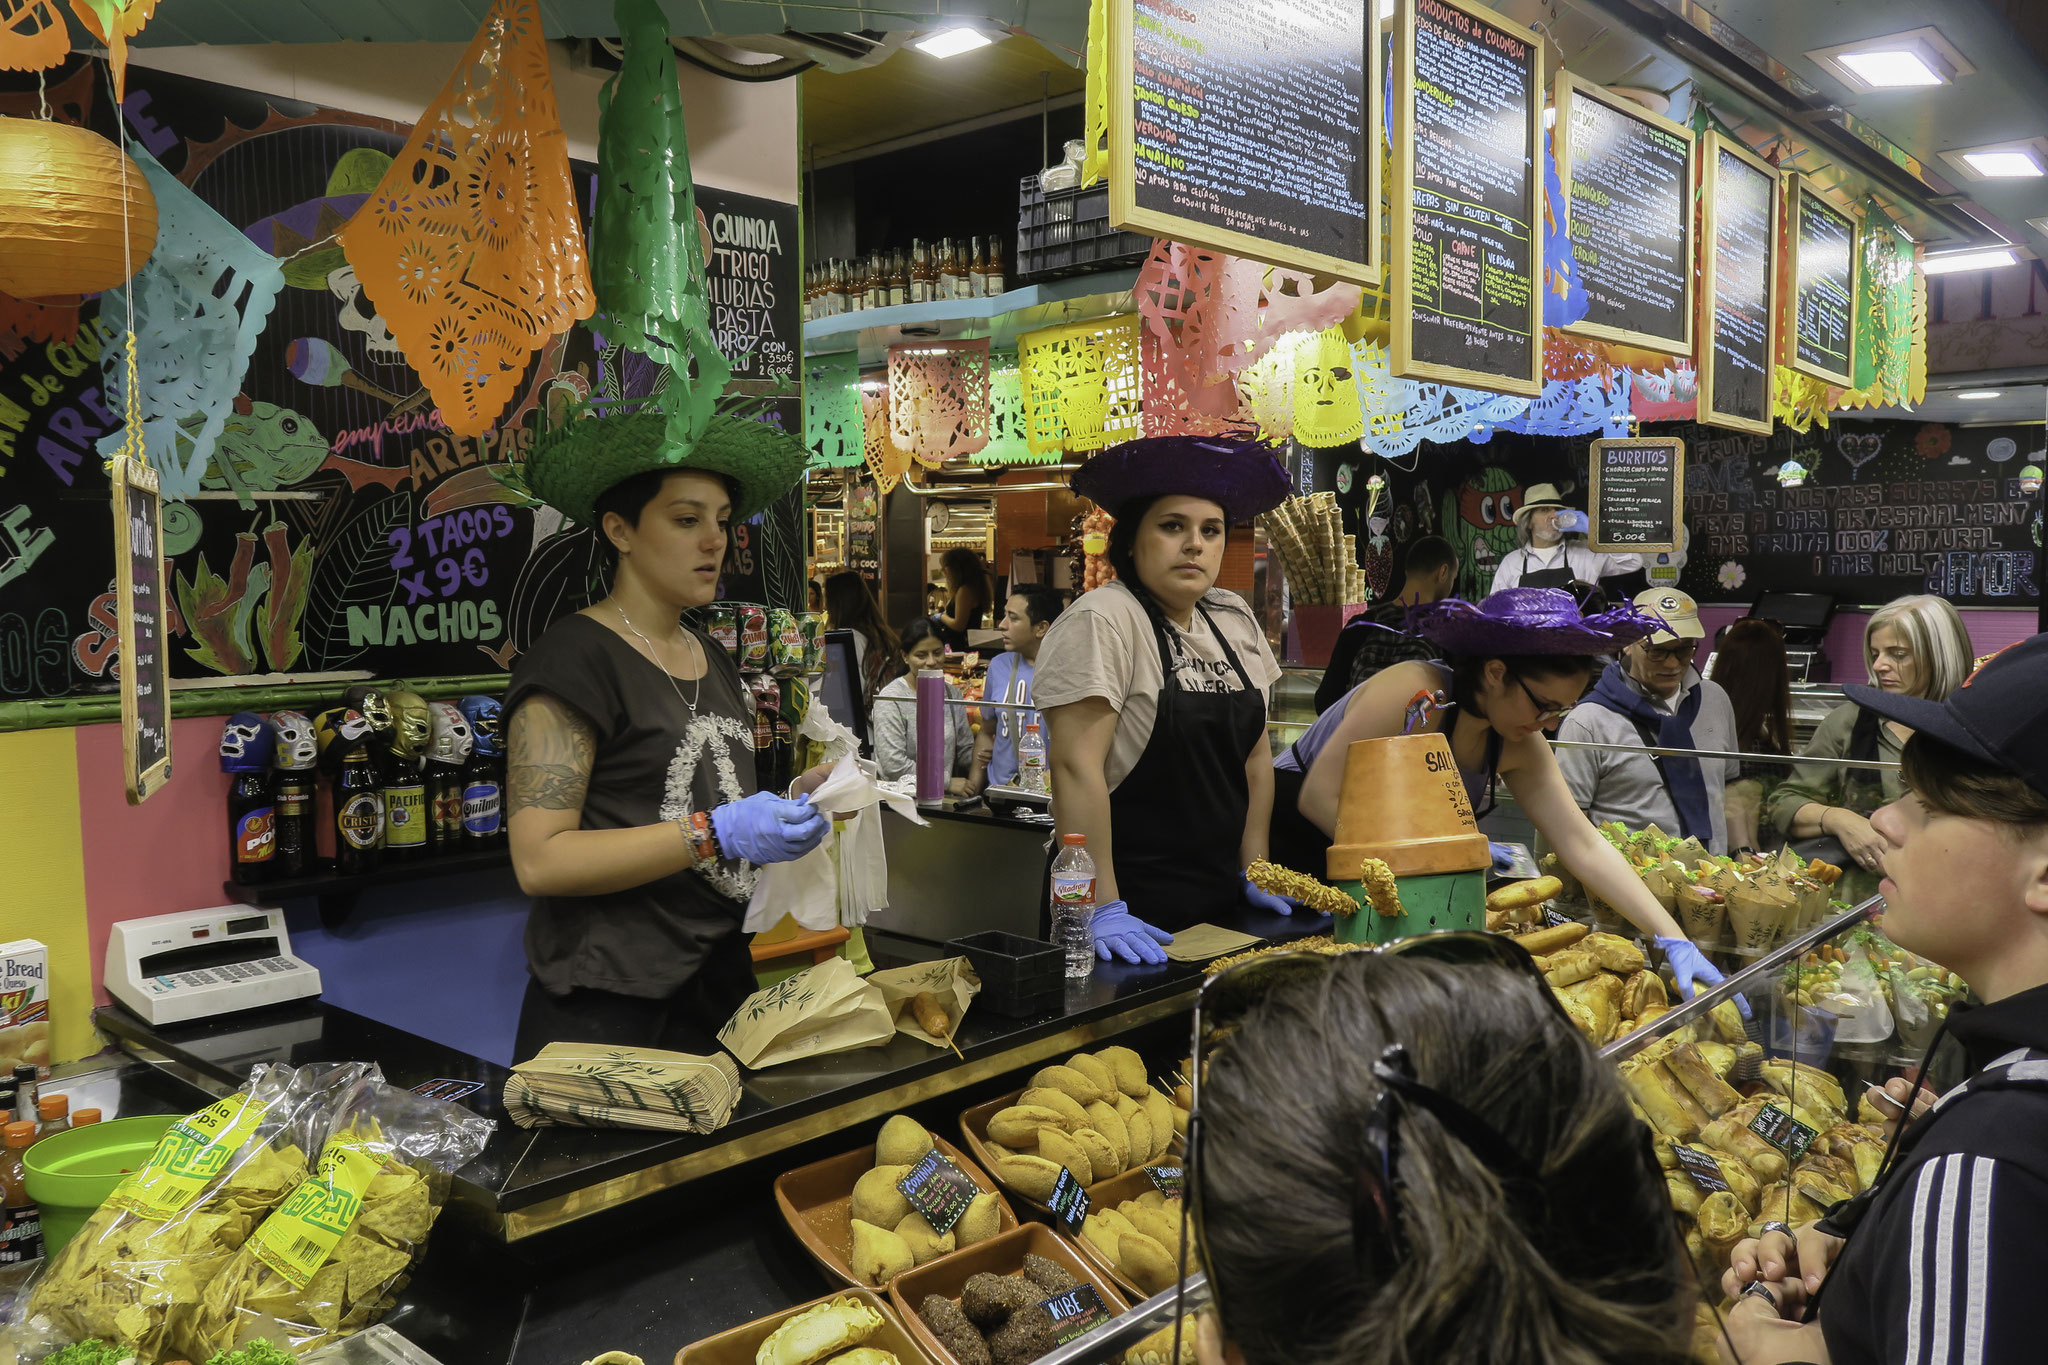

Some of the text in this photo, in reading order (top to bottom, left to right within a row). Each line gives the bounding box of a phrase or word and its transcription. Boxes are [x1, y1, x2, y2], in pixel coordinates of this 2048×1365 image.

[1418, 0, 1524, 63] PRODUCTOS de COLOMBIA
[1160, 48, 1191, 71] QUESO
[1167, 96, 1199, 120] QUESO
[1134, 117, 1176, 144] VERDURA
[1135, 166, 1147, 182] NO
[1415, 161, 1425, 178] NO
[1445, 198, 1458, 216] SIN
[1463, 203, 1490, 224] GLUTEN
[713, 212, 783, 256] QUINOA
[1451, 238, 1476, 259] CARNE
[1487, 251, 1514, 271] VERDURA
[713, 248, 770, 282] TRIGO
[716, 307, 776, 338] PASTA
[762, 341, 786, 354] CON
[410, 427, 534, 492] AREPAS
[1607, 450, 1667, 465] BURRITOS
[1834, 502, 2030, 529] ARTESANALMENT
[388, 505, 514, 571] 2 TACOS
[1612, 532, 1647, 542] 5.00€
[1834, 530, 1889, 552] 100%
[1895, 527, 2003, 550] NATURAL
[435, 547, 489, 596] 9€
[1879, 553, 1942, 576] MOLT
[347, 600, 503, 647] NACHOS
[6, 959, 43, 979] Bread
[4, 978, 27, 990] Queso
[905, 1158, 938, 1194] COXINHA
[1048, 1292, 1083, 1320] KIBE
